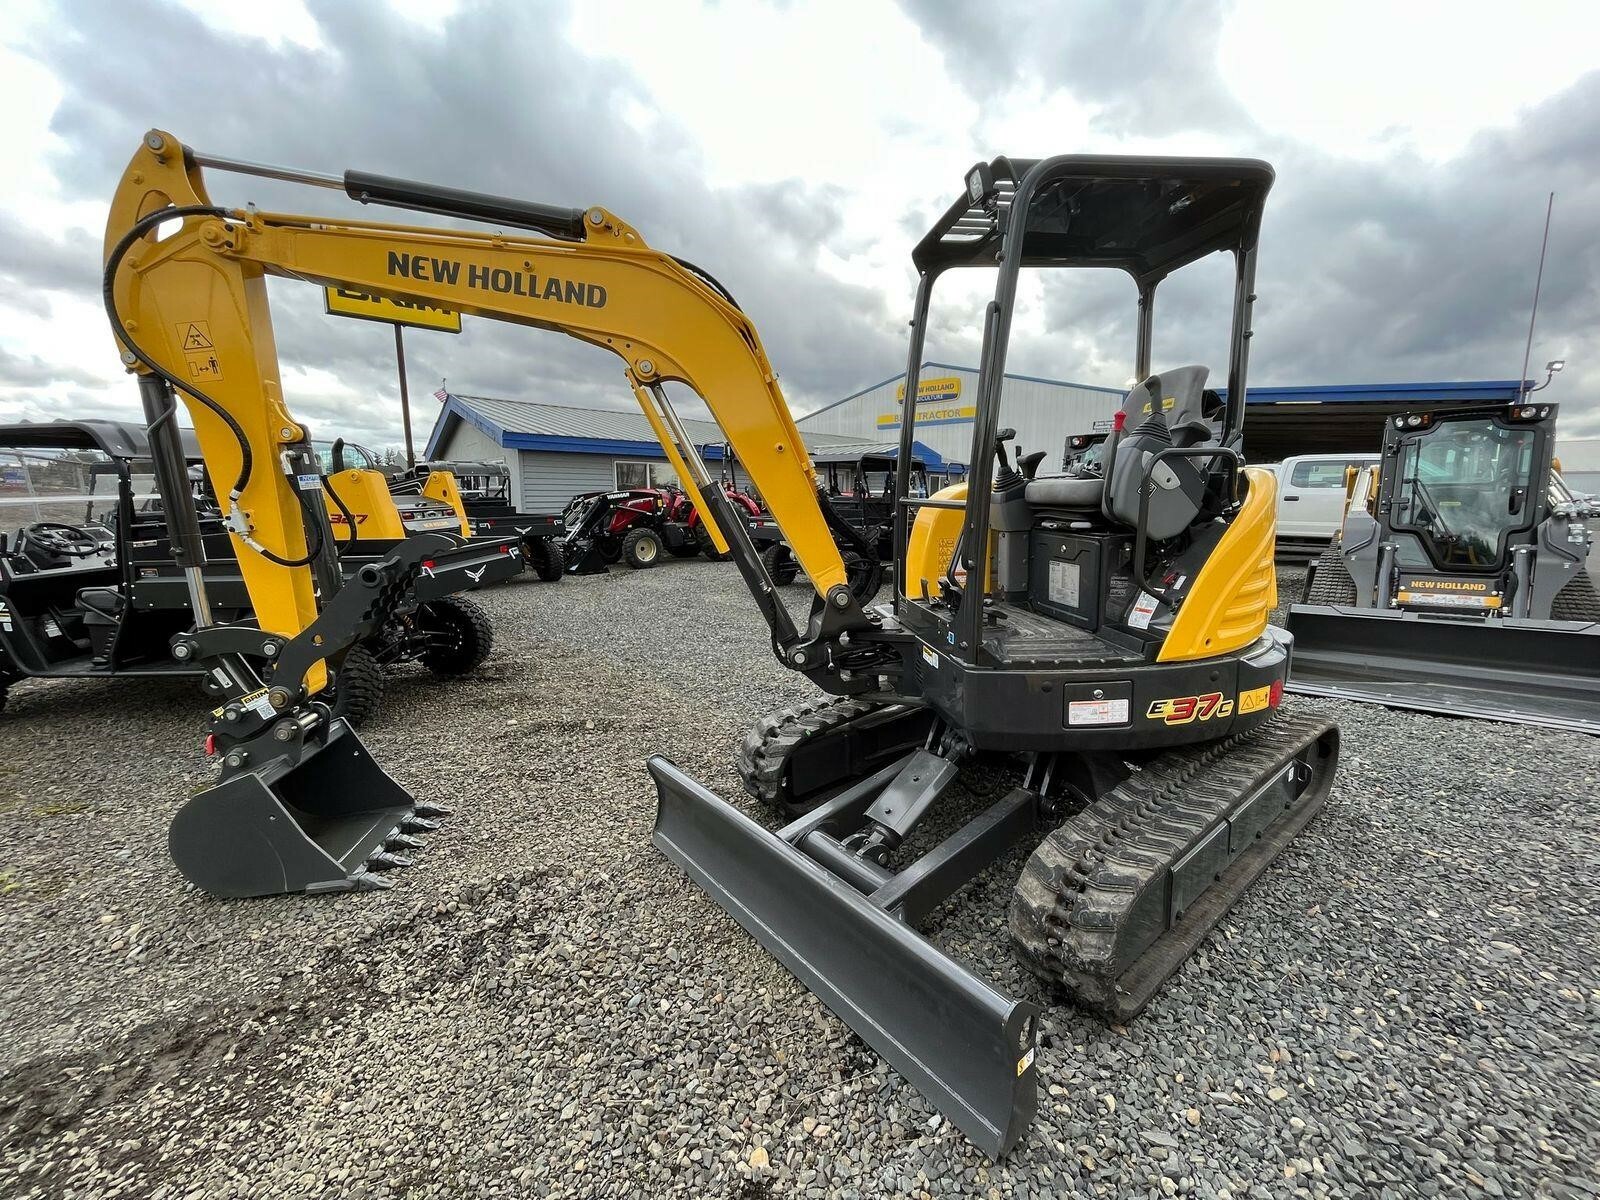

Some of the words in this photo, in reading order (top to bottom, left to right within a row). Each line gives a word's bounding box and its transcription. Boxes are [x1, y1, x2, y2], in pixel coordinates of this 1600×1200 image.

[387, 250, 461, 286] NEW
[467, 264, 608, 309] HOLLAND
[925, 383, 955, 393] HOLLAND
[917, 409, 960, 420] TRACTOR
[1411, 581, 1435, 589] NEW
[1436, 582, 1487, 591] HOLLAND
[243, 689, 270, 704] BRIM
